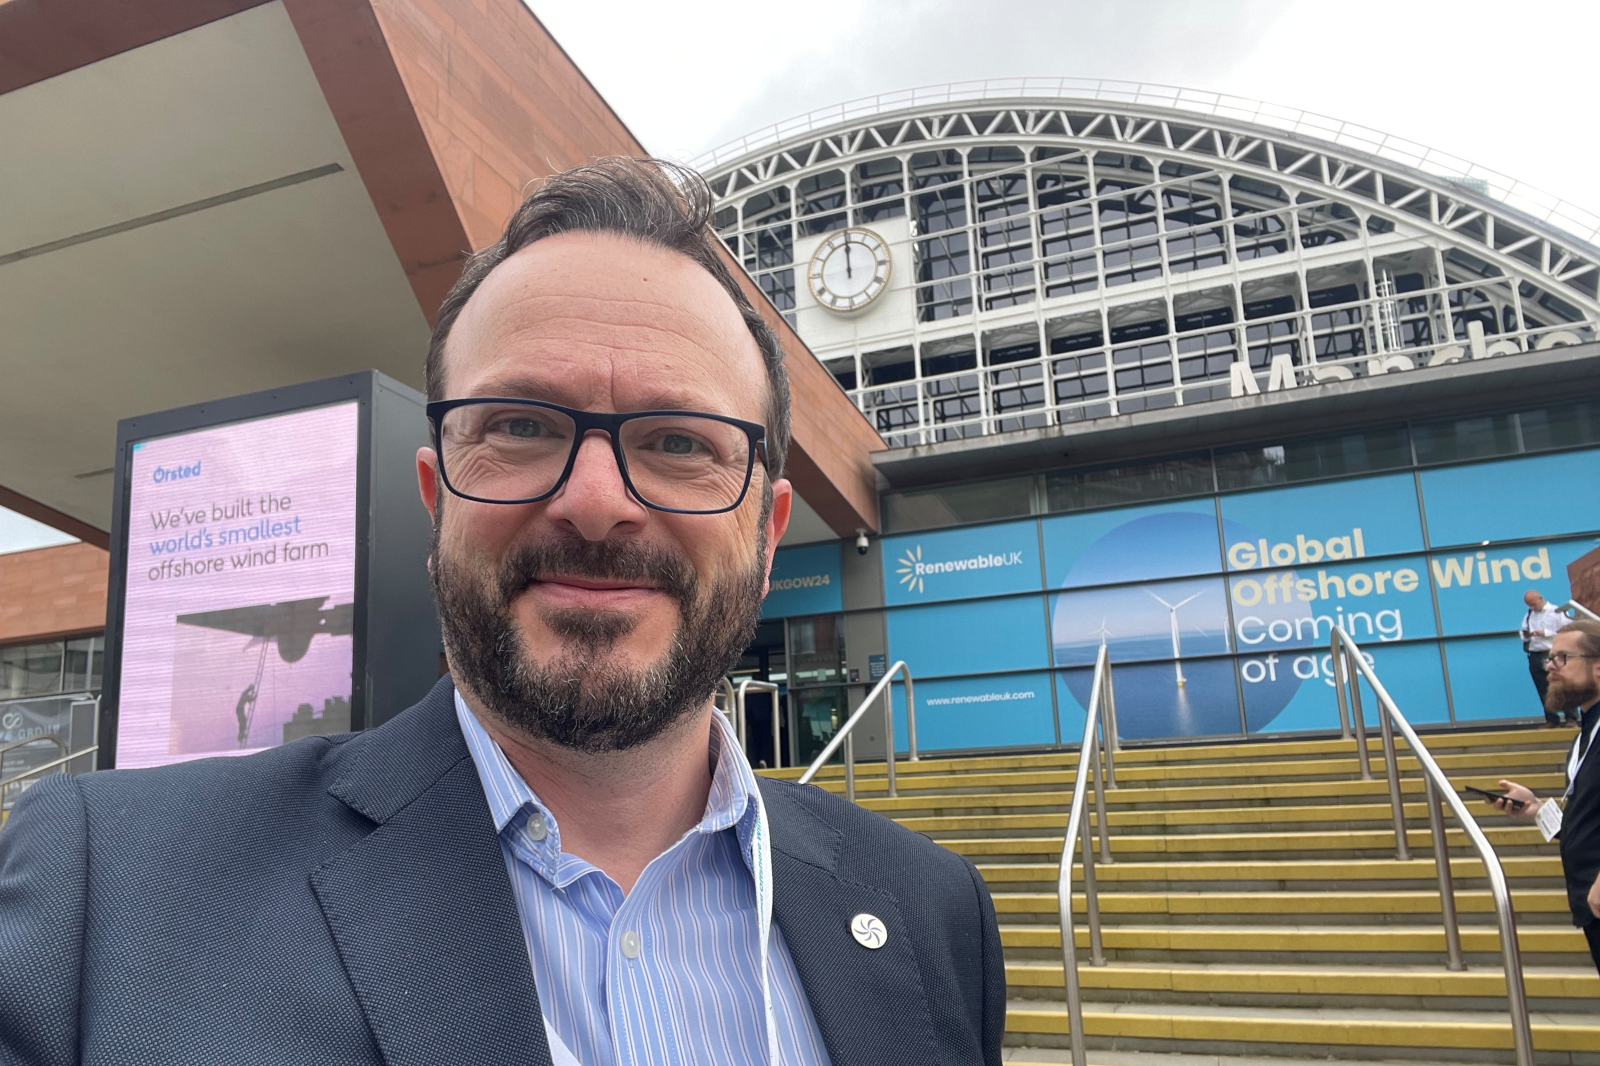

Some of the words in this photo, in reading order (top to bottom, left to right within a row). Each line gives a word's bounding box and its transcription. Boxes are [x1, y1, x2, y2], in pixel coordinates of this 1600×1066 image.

[151, 508, 206, 529] We've
[212, 498, 252, 521] built
[260, 492, 291, 514] the
[151, 529, 213, 555] world's
[219, 516, 302, 545] smallest
[1228, 528, 1365, 570] Global
[149, 556, 224, 581] offshore
[230, 546, 276, 569] wind
[283, 541, 329, 562] farm
[915, 551, 1022, 575] RenewableUK
[1233, 569, 1419, 607] Offshore
[1432, 548, 1551, 588] Wind
[1237, 606, 1403, 644] Coming
[1241, 653, 1279, 683] of
[926, 691, 1035, 706] www.renewableuk.com
